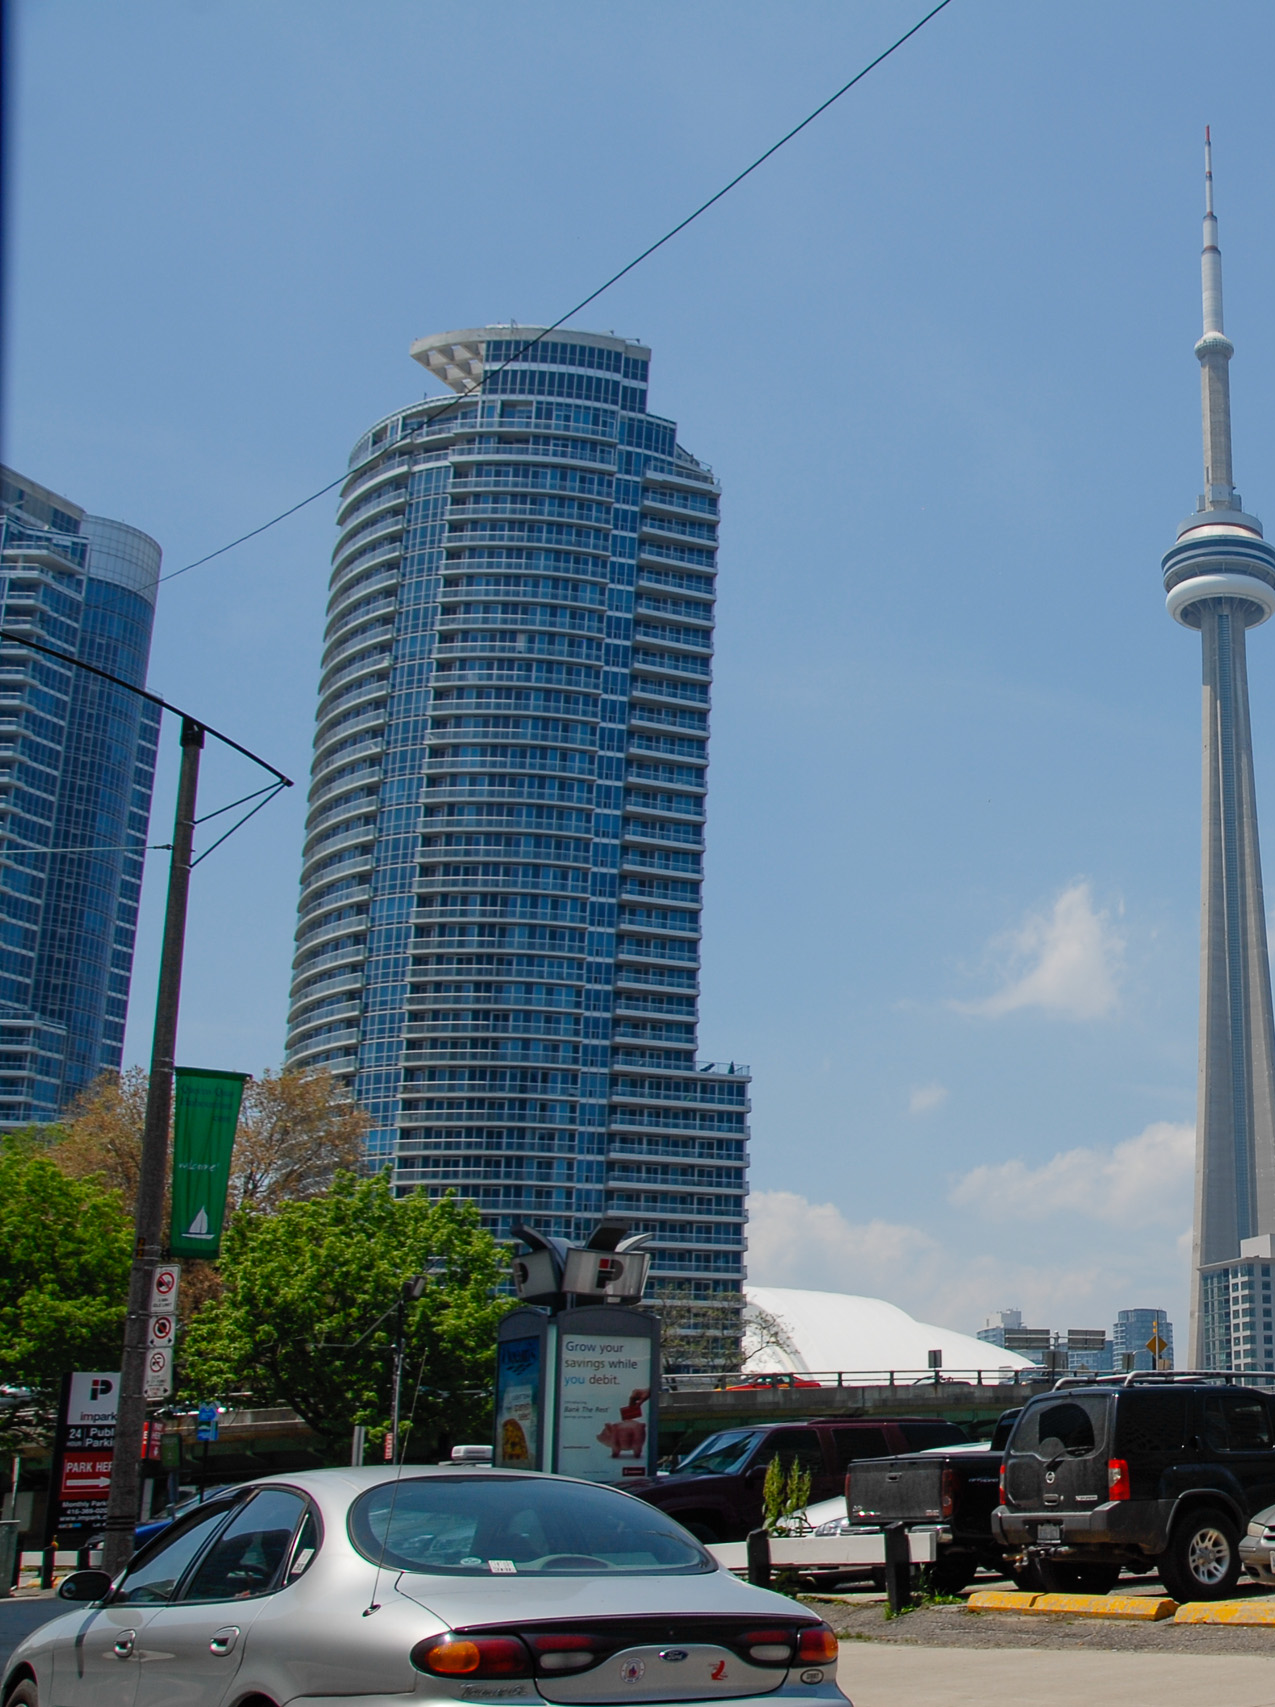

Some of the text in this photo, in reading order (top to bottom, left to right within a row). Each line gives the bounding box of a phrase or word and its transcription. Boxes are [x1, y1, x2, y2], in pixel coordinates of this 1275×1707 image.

[565, 1341, 624, 1355] Grow your
[565, 1359, 638, 1371] savings while
[564, 1374, 621, 1387] you debit.
[80, 1411, 118, 1423] impark
[69, 1428, 82, 1439] 24
[89, 1428, 115, 1437] Publ
[85, 1438, 114, 1447] Parki
[66, 1462, 93, 1473] PARK
[61, 1501, 90, 1509] Monthly
[666, 1651, 683, 1660] Ford
